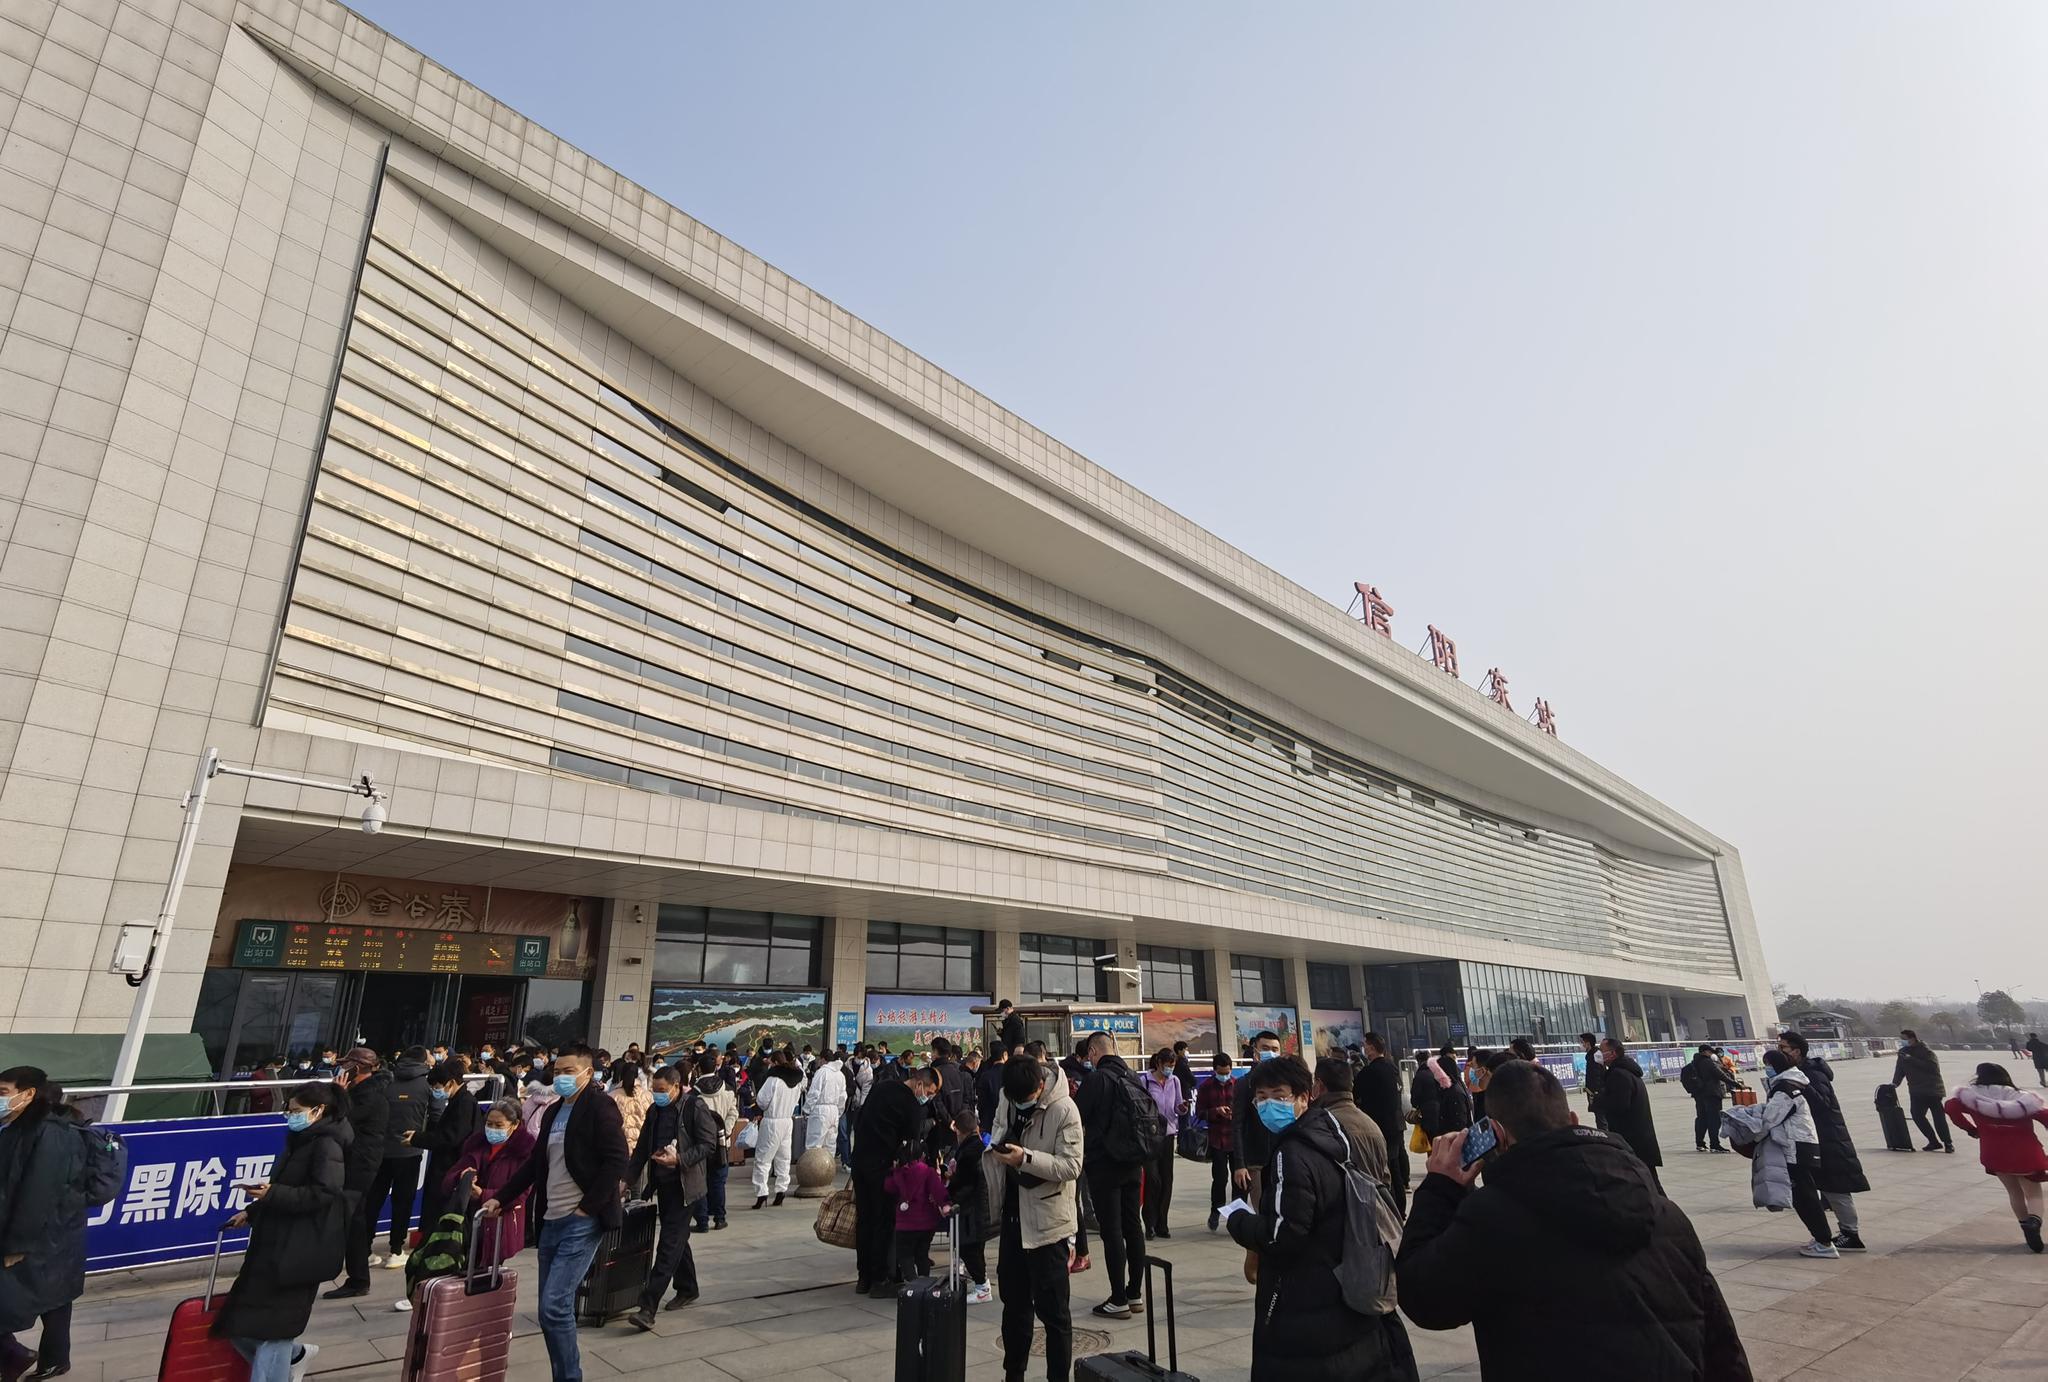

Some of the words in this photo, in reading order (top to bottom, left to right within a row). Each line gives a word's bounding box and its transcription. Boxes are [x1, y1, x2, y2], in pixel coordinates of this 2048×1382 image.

[1354, 582, 1558, 737] 信阳东站
[366, 887, 475, 929] 金谷春
[243, 948, 275, 957] 出站口
[519, 959, 541, 968] 出站口
[1114, 1020, 1135, 1029] POLICE
[88, 1154, 276, 1227] 黑除恶
